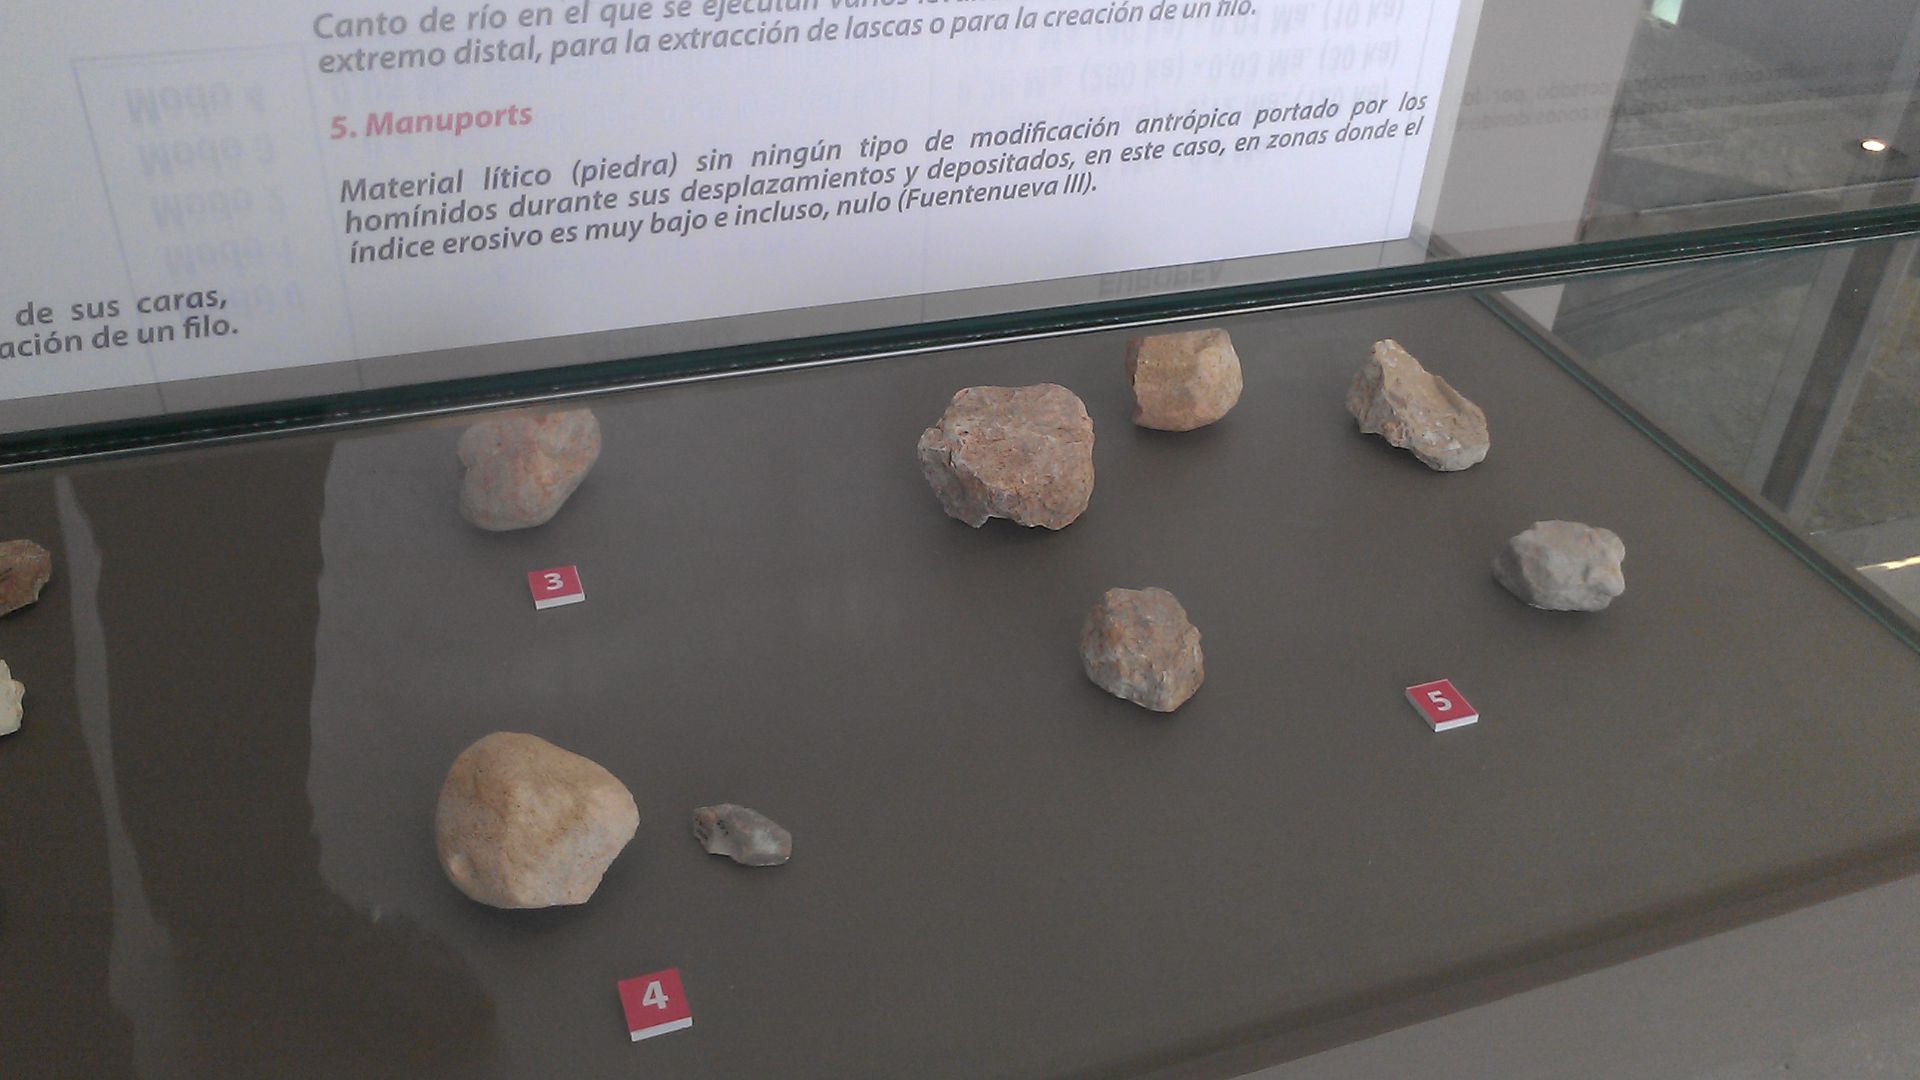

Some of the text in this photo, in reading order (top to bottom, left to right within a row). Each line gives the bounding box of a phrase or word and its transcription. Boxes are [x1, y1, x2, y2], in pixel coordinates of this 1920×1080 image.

[312, 13, 408, 39] Canto
[419, 6, 456, 33] de
[467, 3, 507, 30] río
[518, 6, 553, 27] en
[564, 0, 589, 24] el
[600, 0, 653, 28] que
[663, 0, 693, 18] se
[318, 46, 446, 73] extremo
[454, 35, 542, 65] distal,
[550, 36, 617, 64] para
[625, 29, 650, 54] la
[658, 20, 799, 51] extracción
[807, 17, 839, 42] de
[845, 16, 923, 39] lascas
[929, 16, 945, 34] o
[949, 12, 1010, 39] para
[1015, 6, 1037, 29] la
[1043, 1, 1144, 27] creación
[1150, 0, 1177, 20] de
[1182, 2, 1211, 19] un
[330, 104, 533, 140] 5. Manuports
[340, 91, 1428, 203] Material lítico (piedra) sin ningún tipo de modificación antrópica portado por los
[346, 116, 1424, 234] homínidos durante sus desplazamientos y depositados, en este caso, en zonas donde el
[350, 171, 1097, 264] índice erosivo es muy bajo e incluso, nulo (Fuentenueva III).
[15, 301, 54, 326] de
[71, 300, 120, 321] sus
[137, 289, 227, 314] caras,
[0, 314, 239, 359] ación de un filo.
[544, 572, 564, 591] 3
[1427, 690, 1453, 711] 5
[642, 980, 669, 1009] 4
